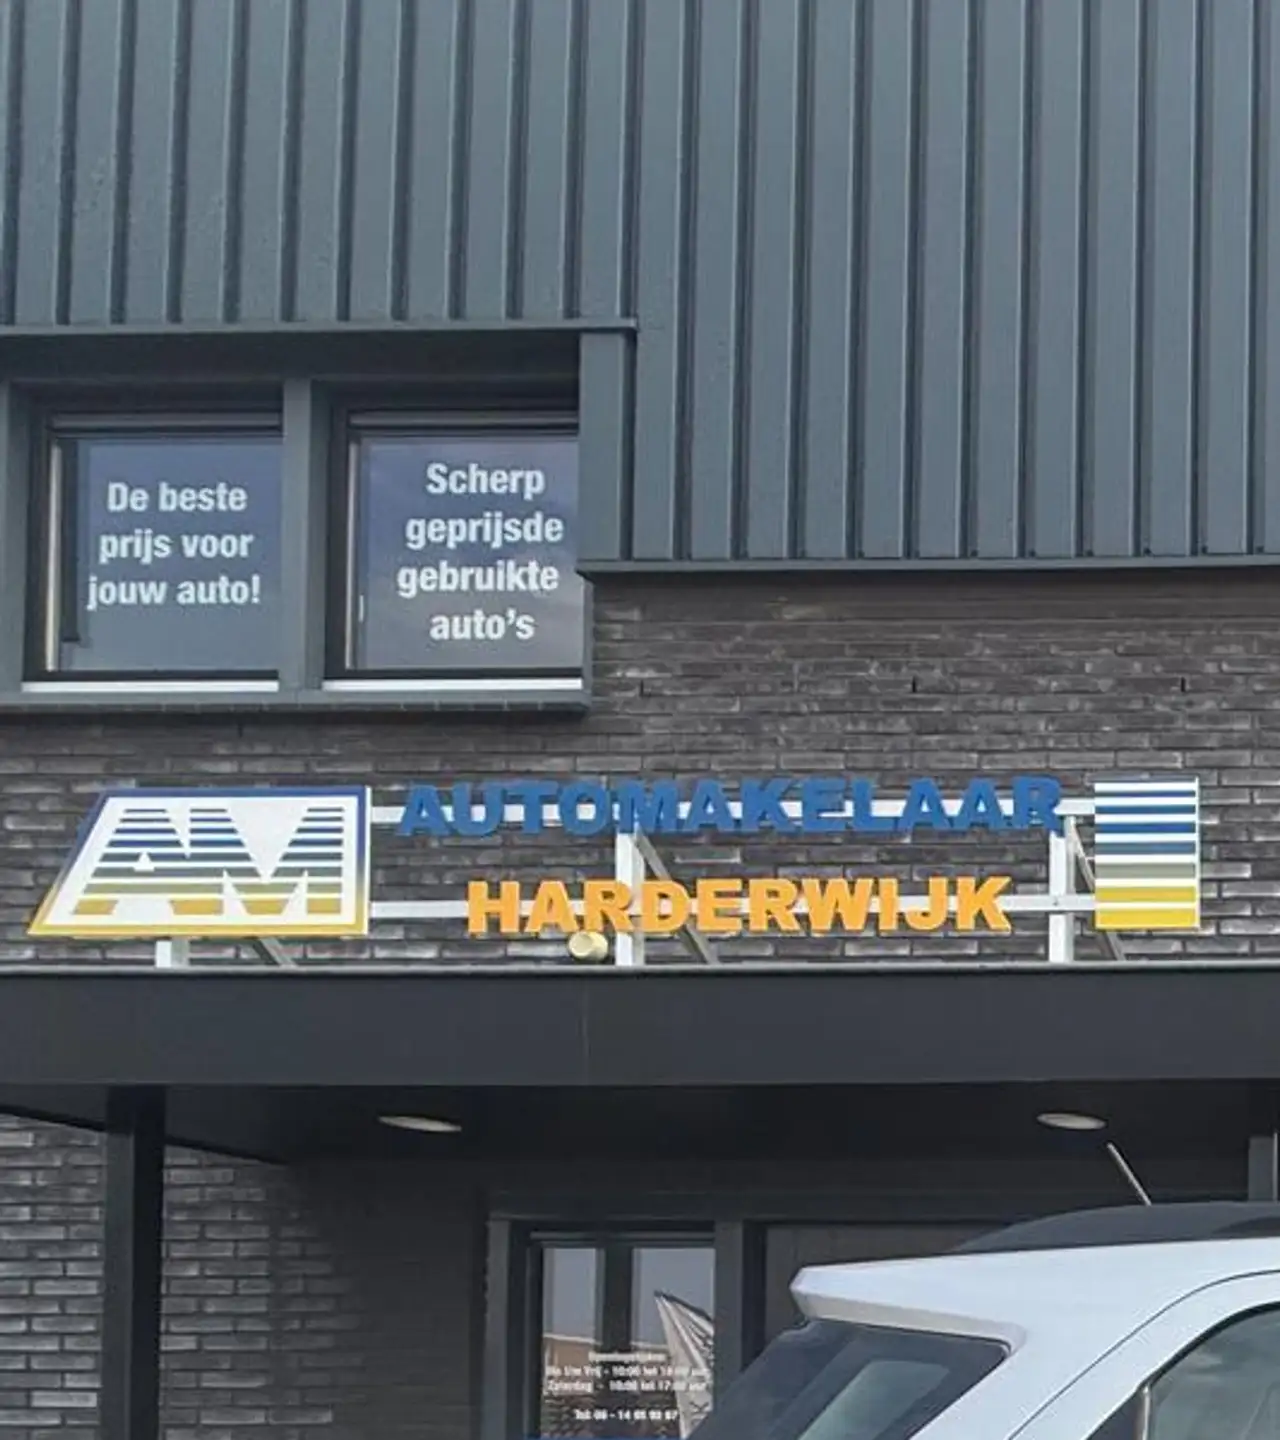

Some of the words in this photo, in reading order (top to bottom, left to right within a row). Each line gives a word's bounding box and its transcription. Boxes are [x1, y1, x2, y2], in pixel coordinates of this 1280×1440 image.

[108, 483, 148, 512] De
[159, 482, 247, 512] beste
[426, 464, 544, 499] Scherp
[100, 528, 170, 565] prijs
[182, 534, 253, 558] voor
[406, 512, 563, 548] geprijsde
[87, 576, 167, 611] jouw
[177, 575, 260, 603] auto!
[398, 561, 558, 598] gebruikte
[430, 608, 535, 640] auto's
[400, 776, 1062, 836] AUTOMAKELAAR
[467, 876, 1012, 934] HARDERWIJK
